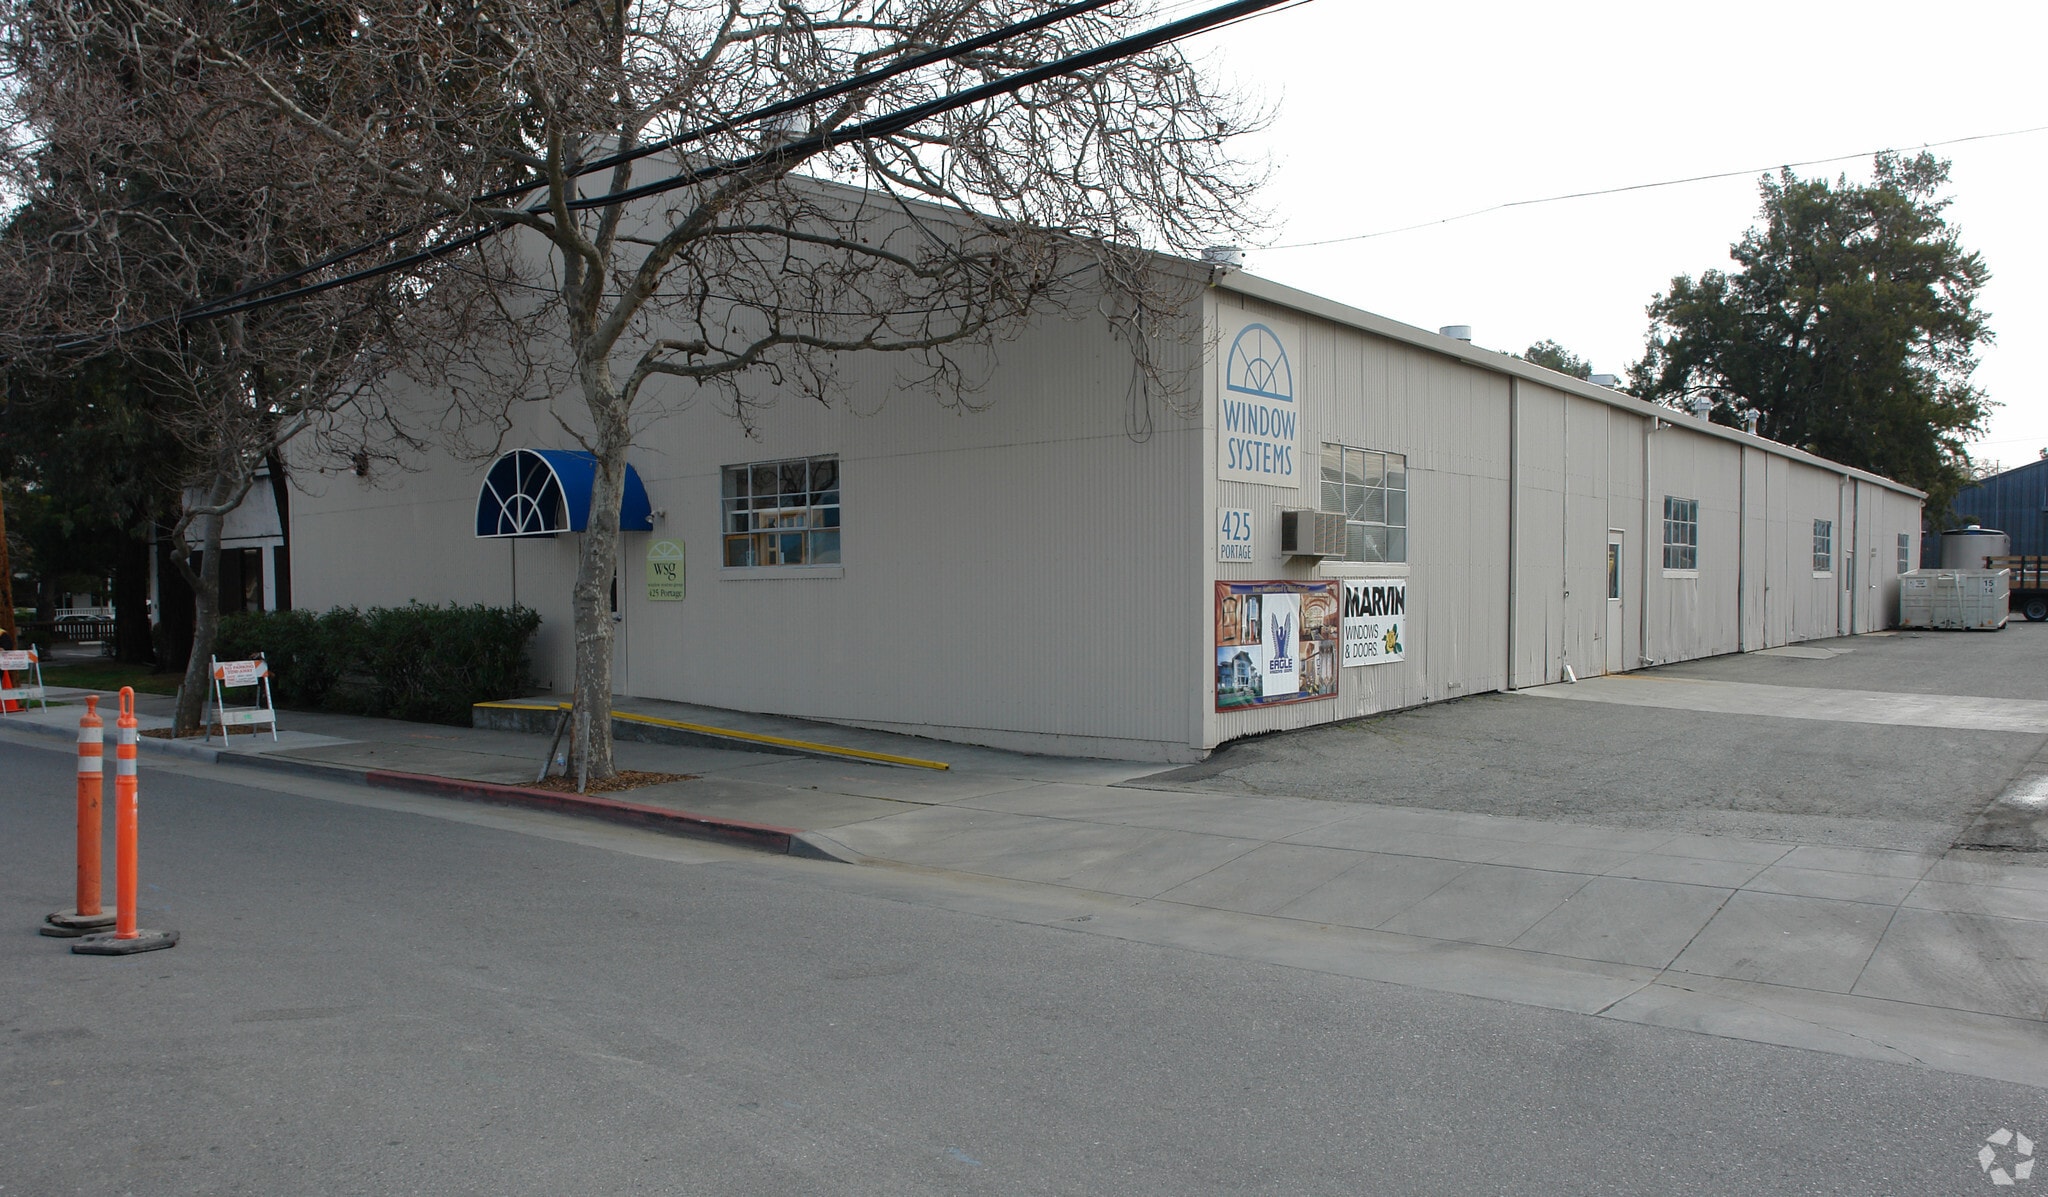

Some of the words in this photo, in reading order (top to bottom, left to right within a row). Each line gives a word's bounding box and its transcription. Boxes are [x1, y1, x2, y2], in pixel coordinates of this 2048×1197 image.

[1223, 399, 1296, 441] WINDOW
[1228, 437, 1292, 476] SYSTEMS
[1221, 511, 1250, 541] 425
[1221, 544, 1252, 560] PORTAGE
[1983, 579, 1994, 588] 15
[648, 588, 660, 598] 425
[660, 588, 683, 599] Portage
[1344, 586, 1405, 617] MARVIN
[1345, 623, 1379, 641] WINDOWS
[1345, 644, 1350, 659] &
[1270, 658, 1293, 670] EAGLE
